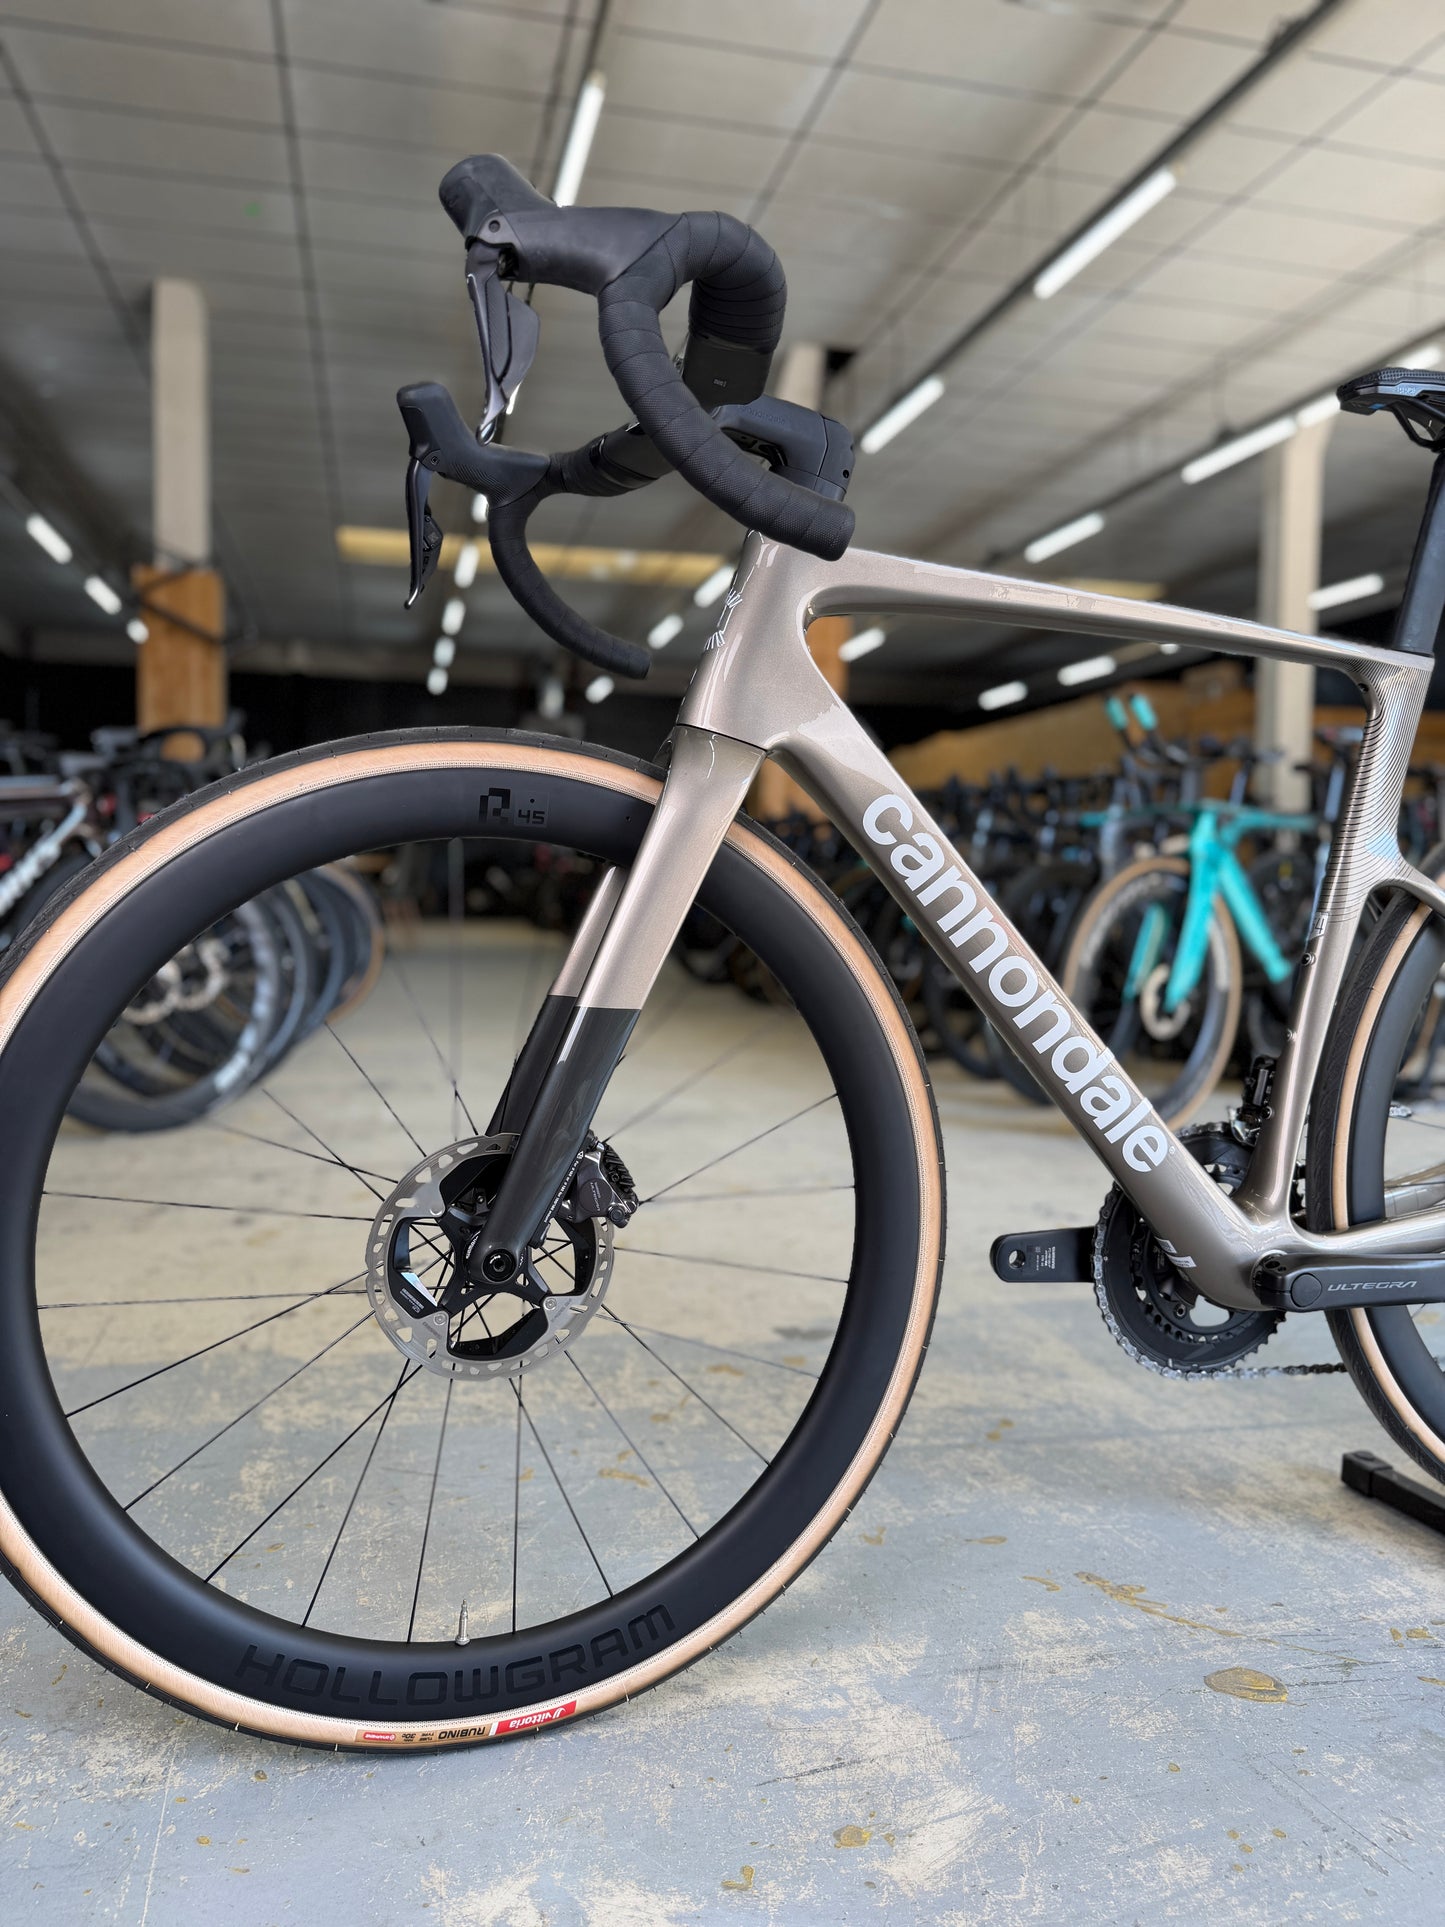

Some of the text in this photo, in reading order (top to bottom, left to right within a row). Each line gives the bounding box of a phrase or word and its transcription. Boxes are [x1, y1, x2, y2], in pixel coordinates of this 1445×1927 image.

[518, 809, 545, 825] 45
[862, 794, 1168, 1173] cannondale
[1327, 1281, 1418, 1292] ULTEGRA
[234, 1603, 676, 1706] HOLLOWGRAM
[509, 1711, 552, 1729] vittoria
[438, 1726, 486, 1740] RUBINO
